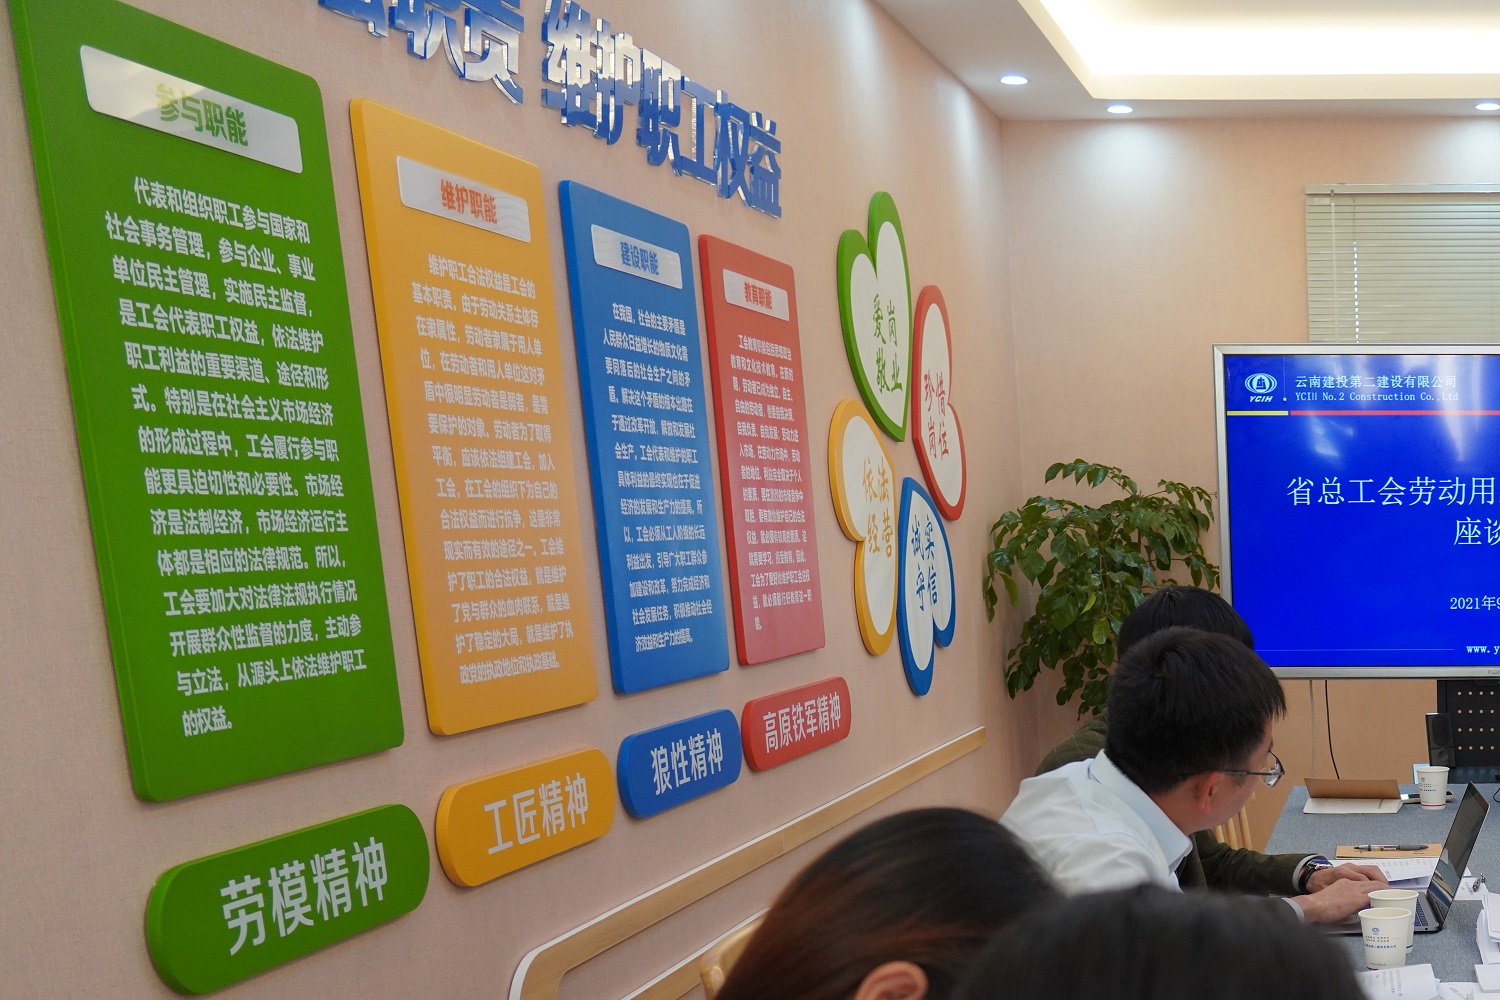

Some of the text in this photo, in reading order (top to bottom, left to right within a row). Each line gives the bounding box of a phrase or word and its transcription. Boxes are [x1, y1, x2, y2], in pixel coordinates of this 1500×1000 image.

[155, 82, 249, 147] 参与职能
[133, 175, 311, 245] 代表和组织职工参与国家和
[440, 178, 498, 225] 维护职能
[104, 210, 316, 282] 社会事务管理，参与企业、事业
[619, 241, 660, 276] 建设职能
[112, 254, 313, 318] 单位民主管理，实施民主监督，
[118, 297, 324, 354] 是工会代表职工权益，依法维护
[872, 293, 898, 347] 爱岗
[124, 341, 330, 391] 职工利益的重要渠道、途径和形
[875, 346, 903, 395] 敬业
[1294, 374, 1457, 389] 云南建投第二建设有限公司
[130, 383, 334, 427] 式。特别是在社会主义市场经济
[1295, 391, 1459, 403] YCIH No.2 Construction Co.,Ltd
[137, 424, 340, 462] 的形成过程中，工会履行参与职
[927, 417, 949, 460] 岗位
[143, 466, 345, 497] 能更具迫切性和必要性。市场经
[149, 508, 349, 536] 济是法制经济，市场经济运行主
[866, 511, 893, 559] 经营
[157, 544, 346, 577] 体都是相应的法律规范。所以，
[163, 579, 358, 616] 工会要加大对法律法规执行情况
[915, 564, 938, 611] 守信
[169, 613, 362, 658] 开展群众性监督的力度，主动参
[176, 648, 368, 697] 与立法，从源头上依法维护职工
[181, 704, 233, 738] 的权益。
[763, 691, 842, 754] 高原铁军精神
[650, 728, 725, 796] 狼性精神
[483, 775, 590, 855] 工匠精神
[219, 836, 389, 957] 劳模精神
